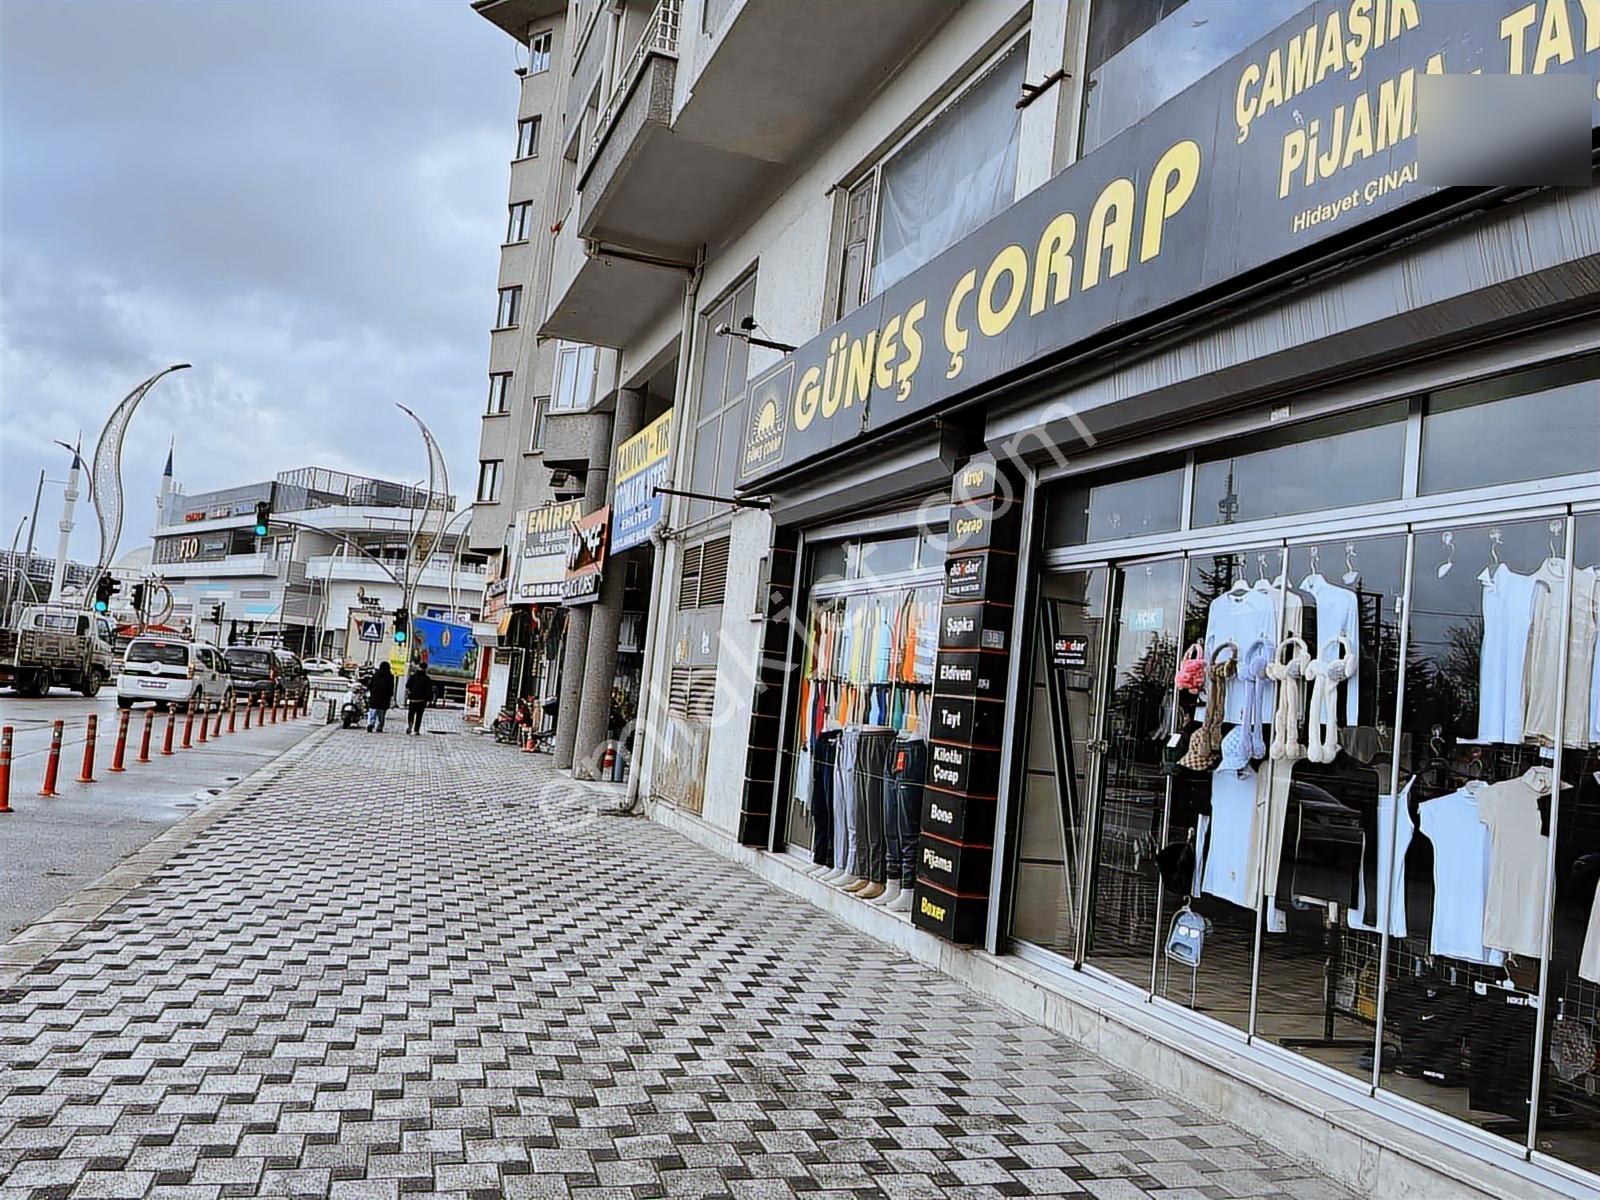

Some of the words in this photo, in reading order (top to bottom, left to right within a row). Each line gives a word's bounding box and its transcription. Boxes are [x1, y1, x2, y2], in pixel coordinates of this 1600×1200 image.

[1234, 0, 1421, 144] ÇAMAŞIR
[1293, 188, 1360, 234] Hidayet
[1363, 160, 1418, 206] ÇINA
[792, 298, 928, 432] GÜNEŞ
[943, 138, 1201, 380] ÇORAP
[962, 468, 985, 488] Krop
[955, 517, 984, 539] Çorap
[180, 536, 199, 559] FLO
[946, 615, 975, 639] Şapka
[939, 664, 973, 683] Eldiven
[941, 709, 962, 729] Tayt
[933, 746, 963, 765] Kilotlu
[933, 764, 959, 783] Çorap
[930, 802, 954, 824] Bone
[923, 847, 953, 873] Pijama
[920, 896, 946, 922] Boxer
